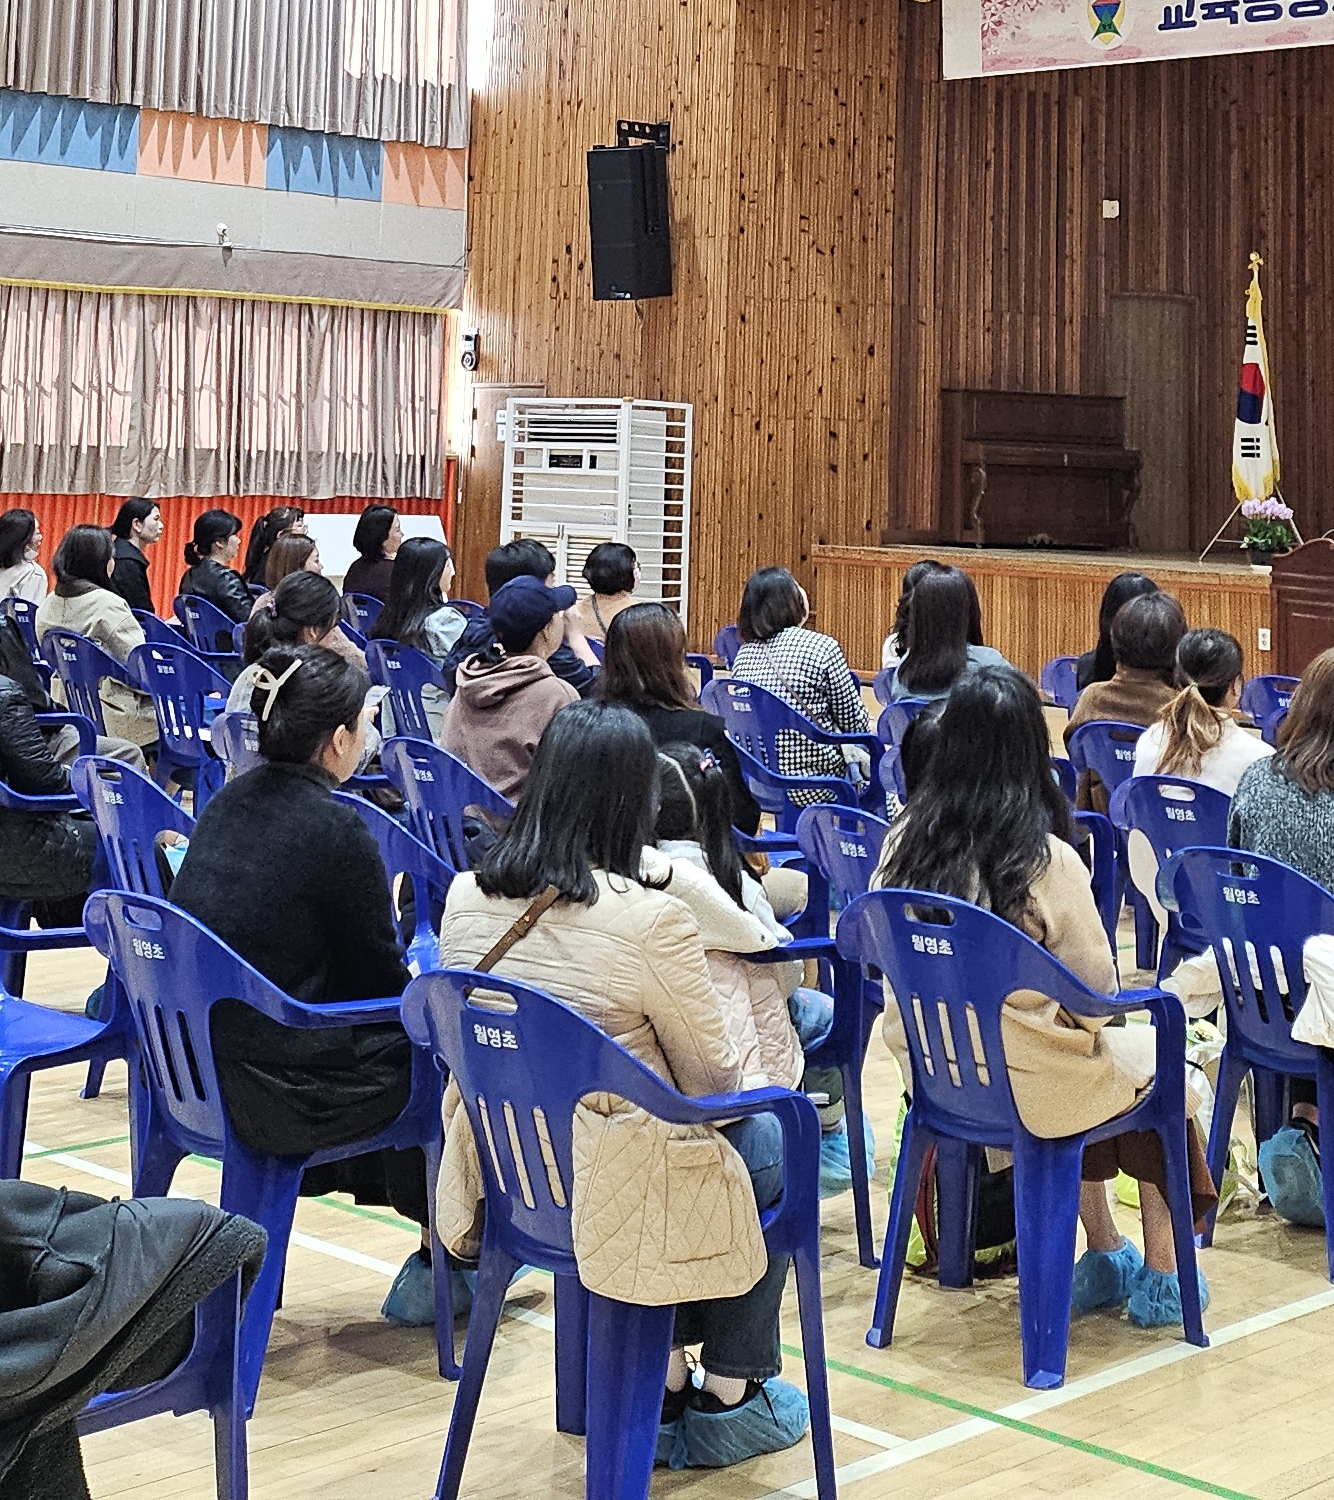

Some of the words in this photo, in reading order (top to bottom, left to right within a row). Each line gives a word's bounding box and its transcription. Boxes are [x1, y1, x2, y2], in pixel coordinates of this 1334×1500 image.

[1223, 886, 1260, 905] 월영초
[132, 938, 165, 960] 월영초
[911, 934, 953, 955] 월영초
[473, 1023, 518, 1049] 월영초
